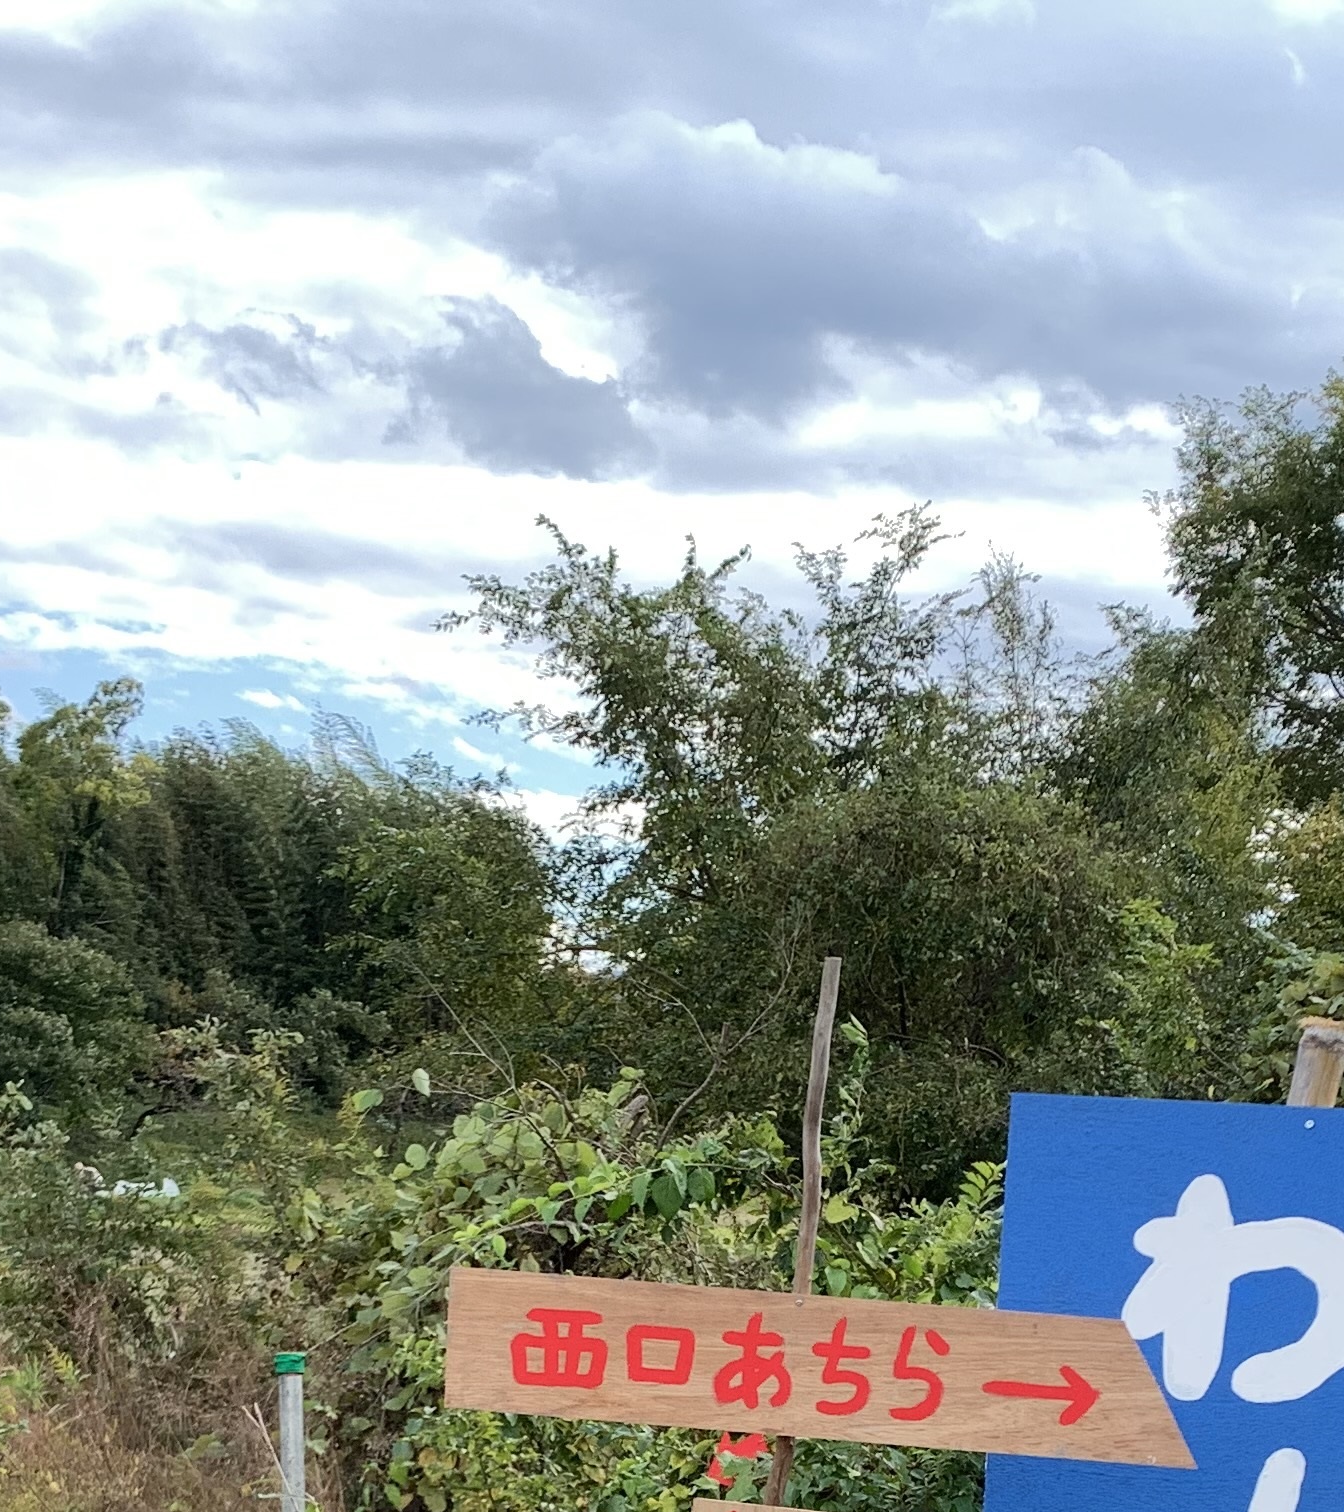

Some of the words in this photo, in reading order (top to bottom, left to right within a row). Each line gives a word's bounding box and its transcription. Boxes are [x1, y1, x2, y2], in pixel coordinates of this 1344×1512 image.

[510, 1307, 950, 1421] 西口あちら
